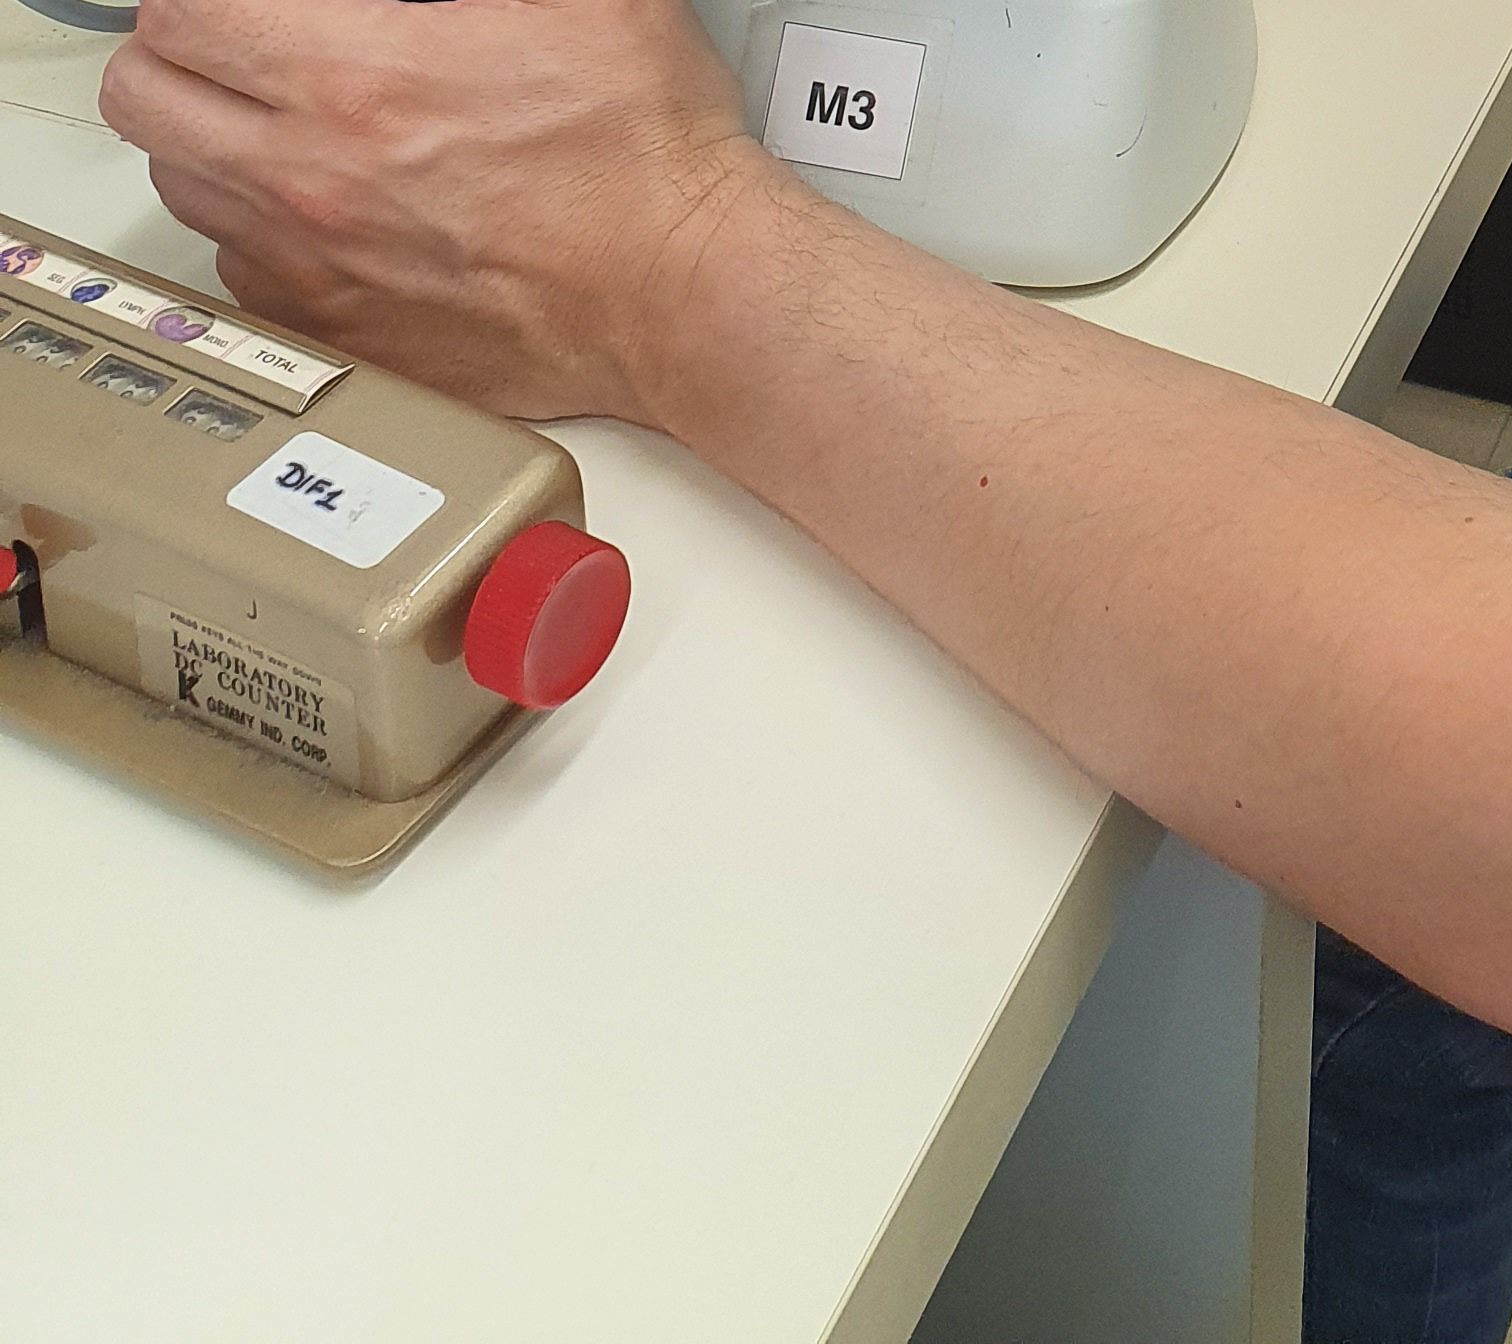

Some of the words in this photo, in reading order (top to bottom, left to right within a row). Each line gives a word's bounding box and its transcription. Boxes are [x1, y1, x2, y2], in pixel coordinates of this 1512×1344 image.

[805, 80, 877, 131] M3
[254, 349, 299, 375] TOTAL
[172, 629, 325, 713] LABORATORY
[173, 649, 203, 675] DC
[217, 670, 328, 737] COUNTER
[178, 670, 203, 708] K
[206, 696, 255, 730] GEMMY
[260, 719, 287, 746] IND.
